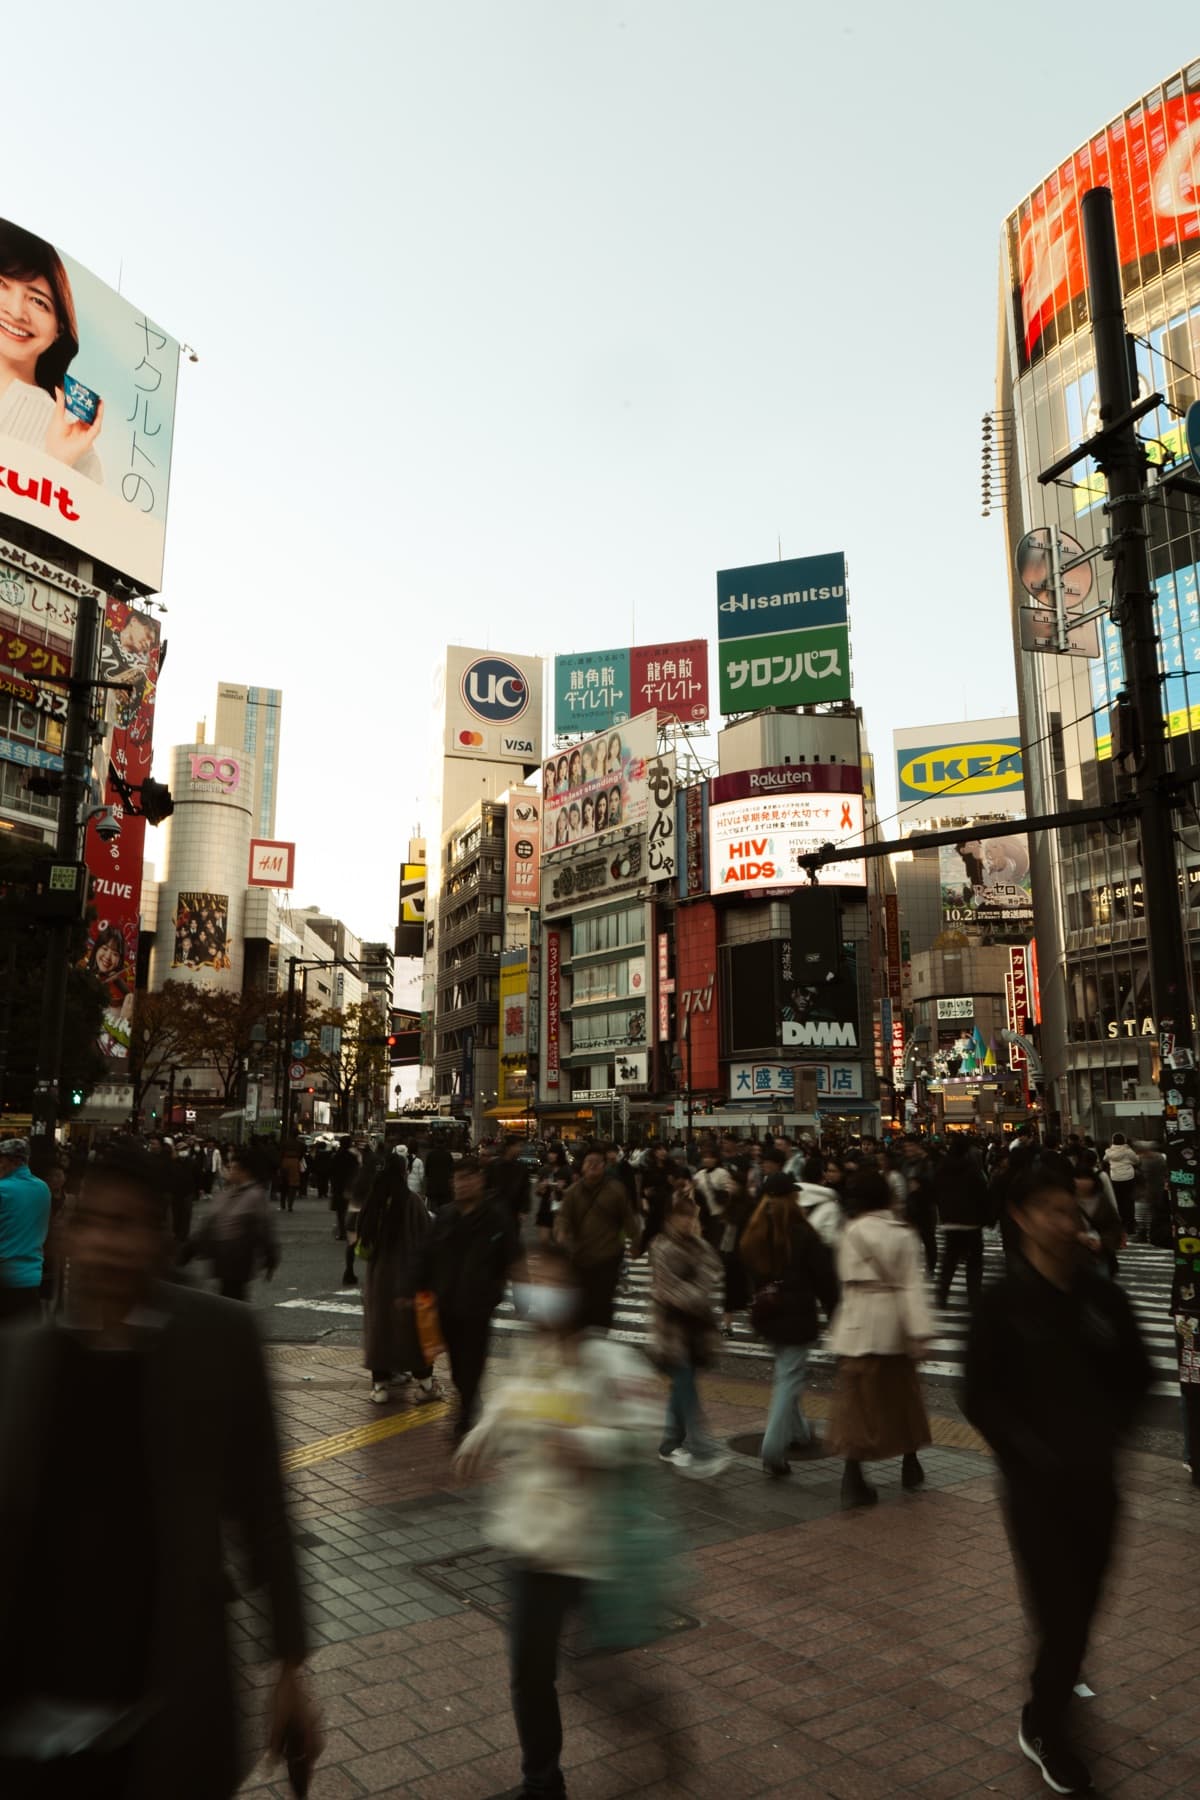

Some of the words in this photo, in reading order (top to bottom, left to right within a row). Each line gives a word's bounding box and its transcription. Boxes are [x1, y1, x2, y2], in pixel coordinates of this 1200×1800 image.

[122, 316, 167, 513] ヤクルトの
[719, 585, 844, 613] Hisamitsu
[0, 633, 66, 677] タクト
[570, 666, 615, 689] 龍角散
[647, 658, 693, 682] 龍角散
[726, 648, 842, 690] サロンパス
[564, 688, 624, 711] ダイレクト
[641, 680, 702, 704] ダイレクト
[505, 739, 533, 753] VISA
[189, 753, 241, 794] 109
[749, 770, 812, 788] Rakuten
[913, 753, 1023, 784] IKEA
[648, 758, 674, 875] もんじゃ
[717, 808, 831, 828] HIVは早期発見が大切です
[729, 838, 769, 860] HIV
[724, 861, 776, 884] AIDS
[1013, 955, 1027, 1009] カラオケ
[939, 1009, 973, 1017] クリニック
[782, 1021, 858, 1047] DMM
[1107, 1016, 1157, 1039] STA
